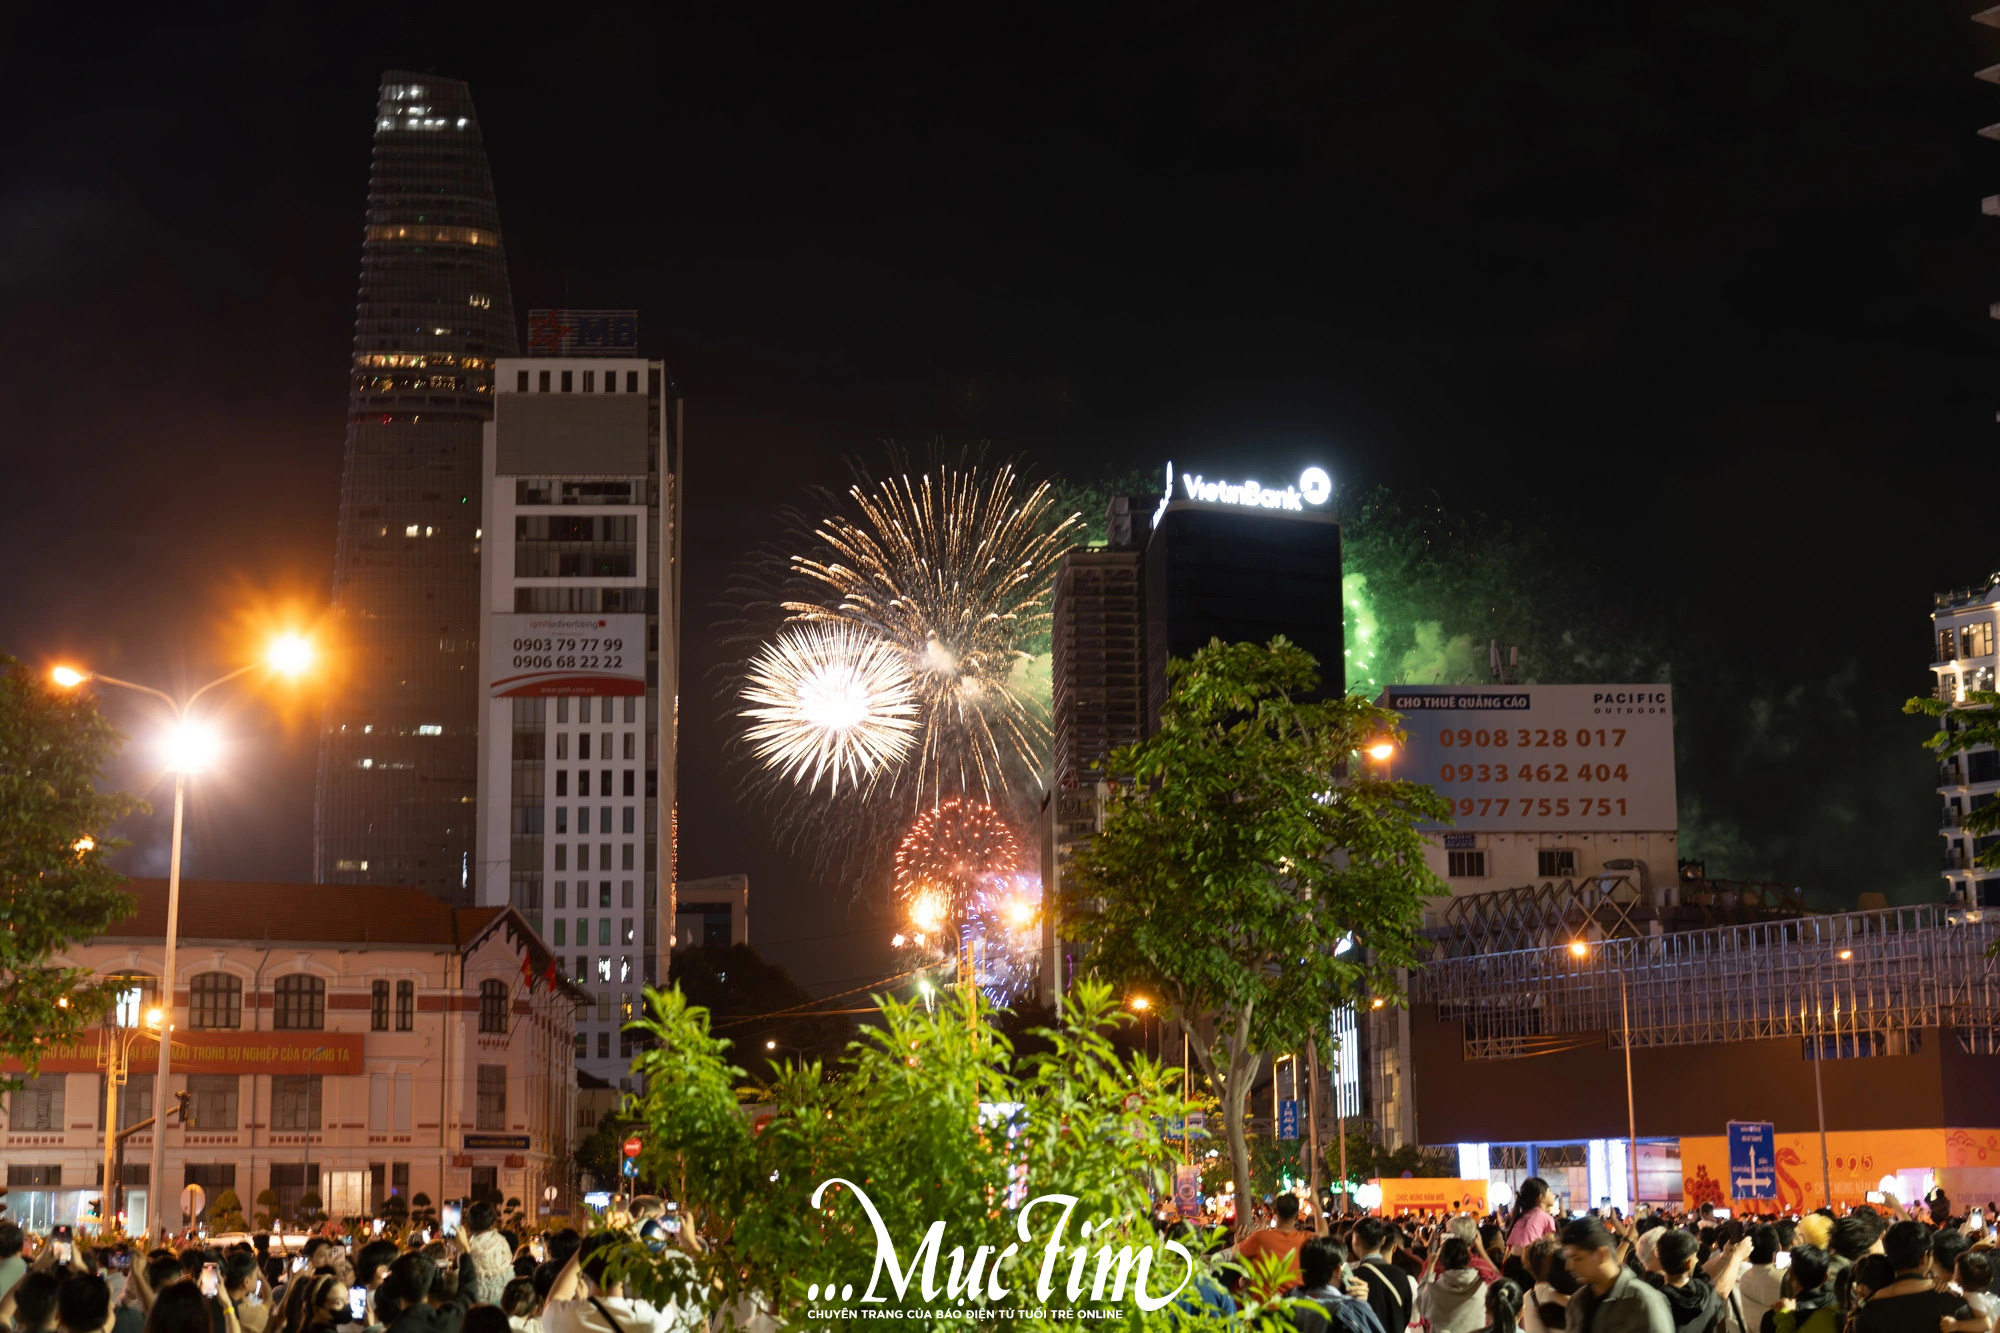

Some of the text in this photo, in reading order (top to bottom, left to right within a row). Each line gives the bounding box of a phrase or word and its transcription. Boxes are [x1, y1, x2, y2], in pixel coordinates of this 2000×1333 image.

[577, 317, 637, 347] MB
[1182, 473, 1304, 512] VietinBank
[513, 638, 623, 651] 0903 79 77 99
[513, 655, 622, 668] 0906 68 22 22
[1396, 694, 1528, 710] CHO THUÊ QUẢNG CÁO
[1593, 692, 1667, 704] PACIFIC
[1593, 707, 1667, 715] OUTDOOR
[1439, 728, 1627, 748] 0908 328 017
[1440, 763, 1629, 783] 0933 462 404
[1519, 797, 1570, 817] 755
[1578, 797, 1628, 817] 751
[193, 1046, 225, 1061] TRONG
[243, 1045, 279, 1064] NGHIỆP
[280, 1044, 300, 1061] CỦA
[337, 1048, 350, 1062] TA
